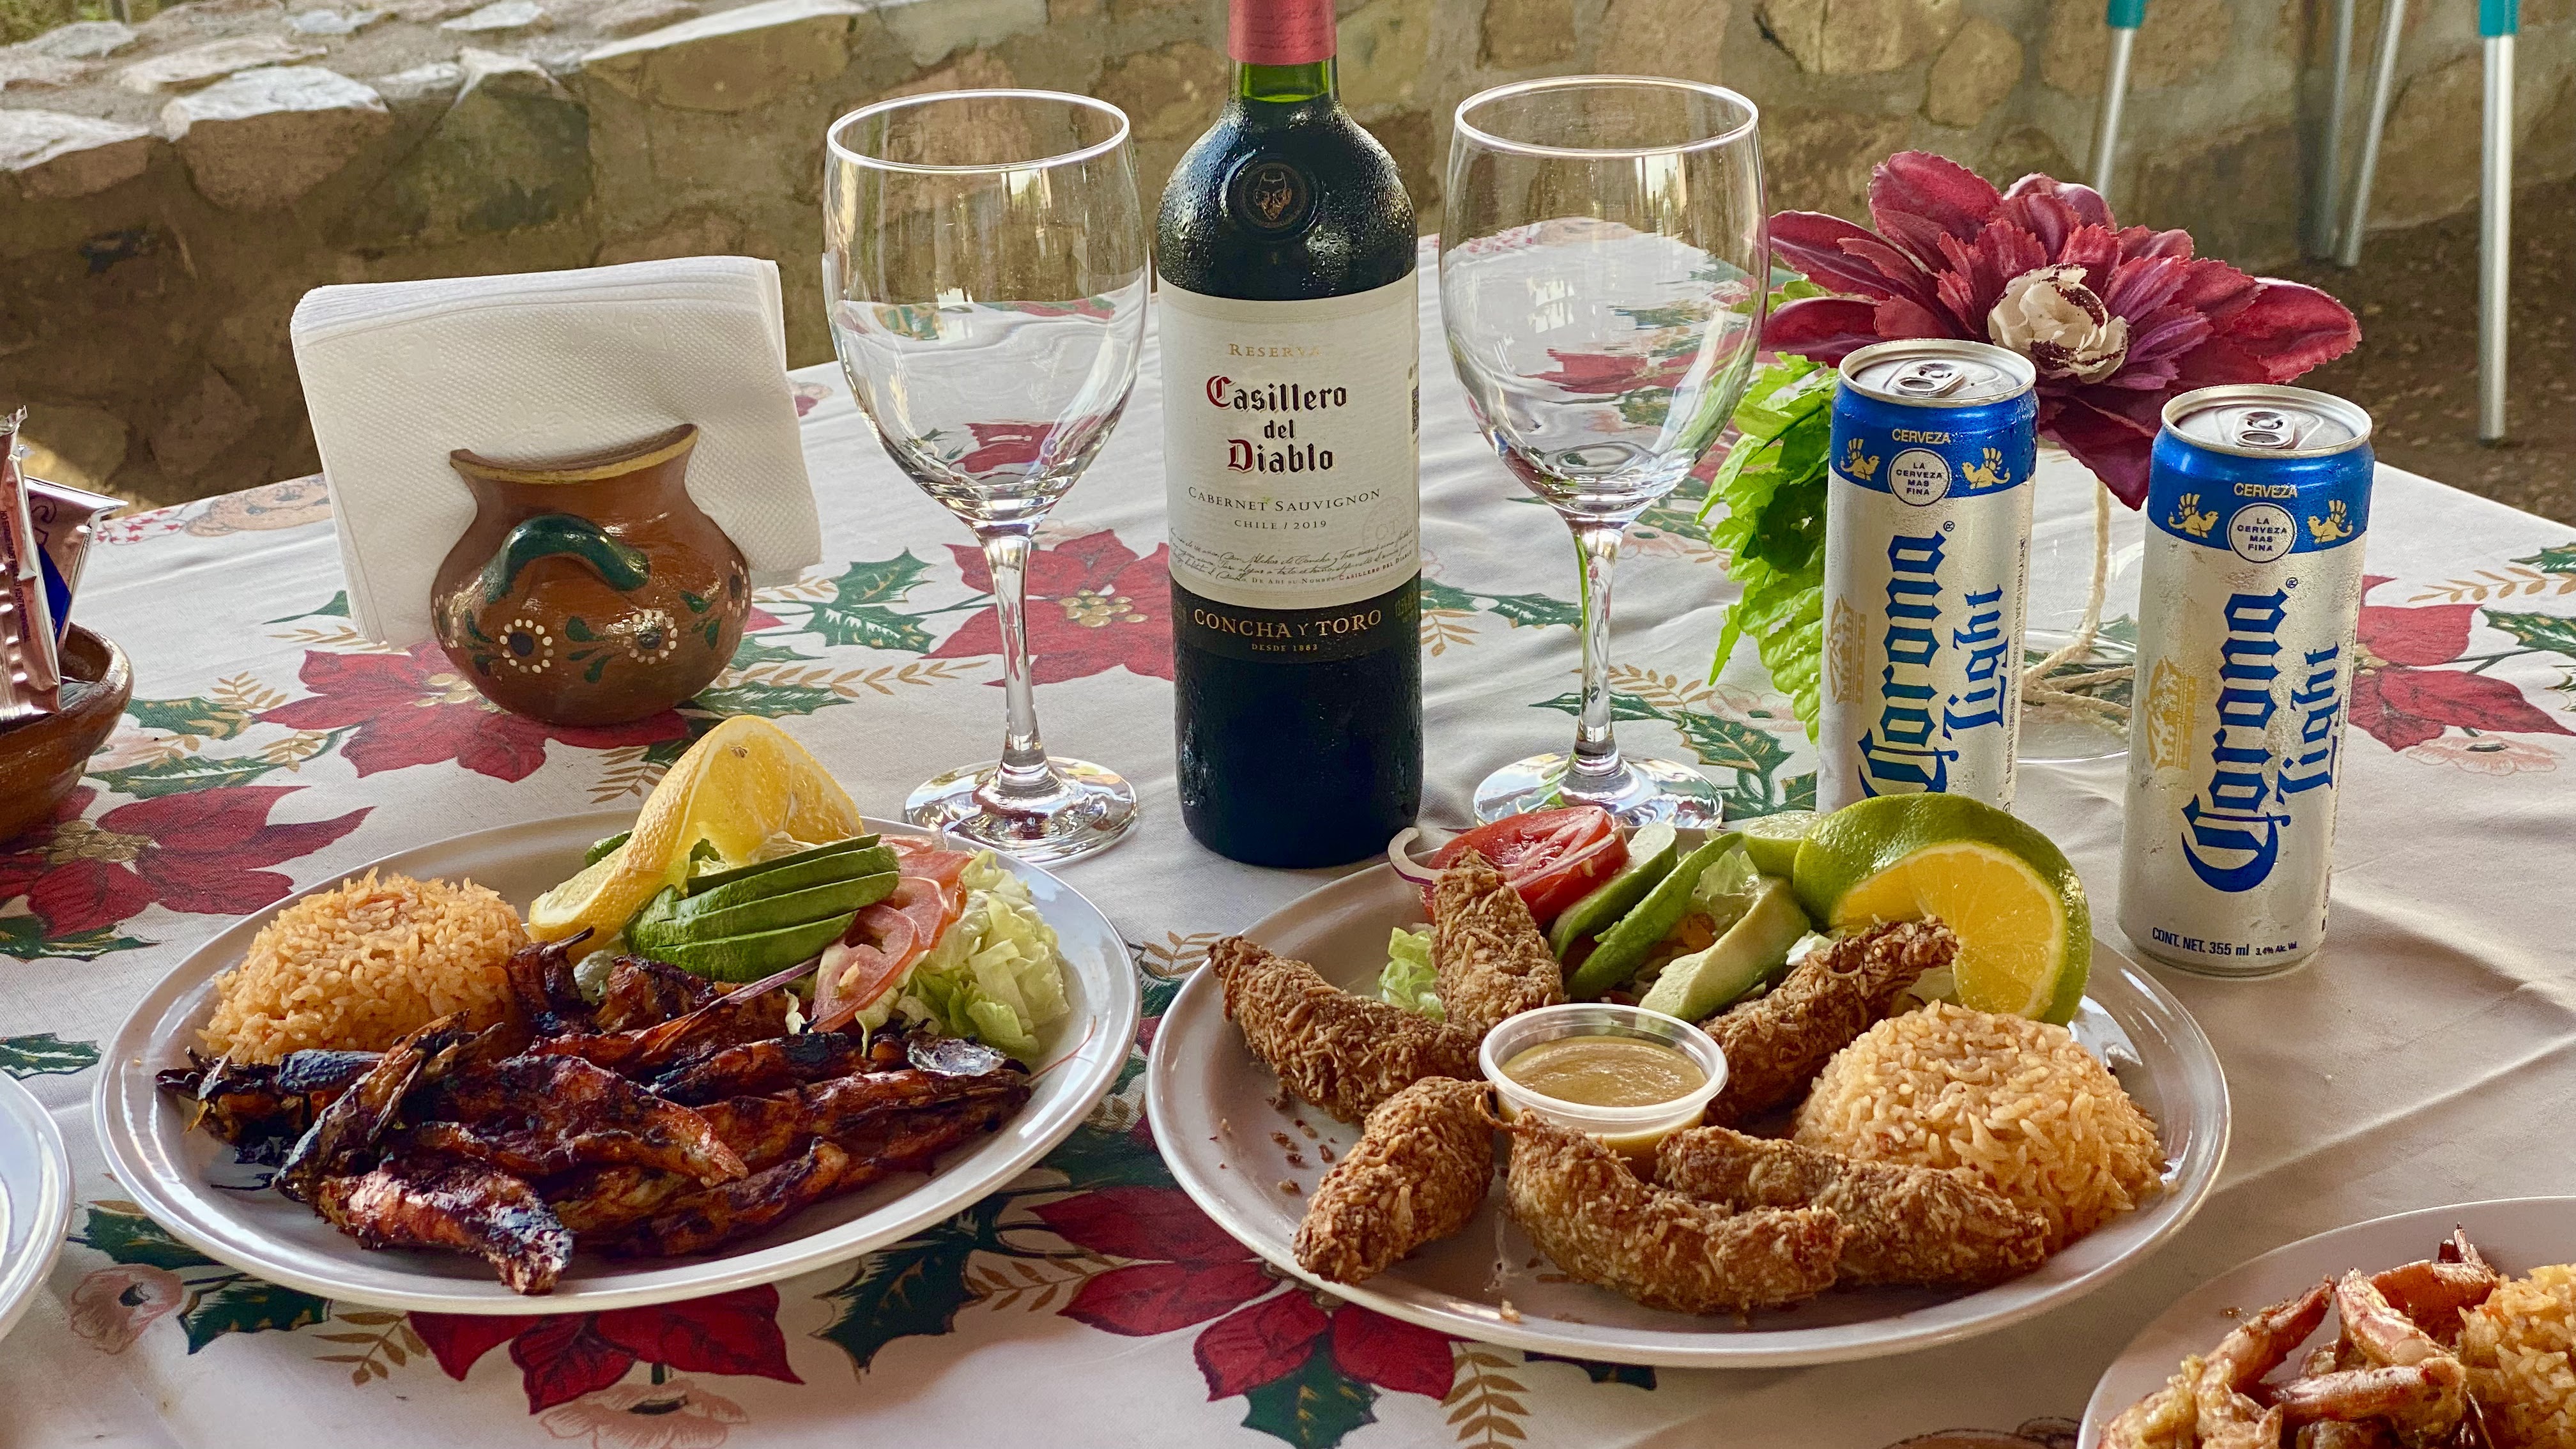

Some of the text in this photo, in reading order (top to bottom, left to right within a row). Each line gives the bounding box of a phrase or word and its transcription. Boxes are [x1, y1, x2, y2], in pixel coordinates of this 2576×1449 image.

[1229, 344, 1322, 357] RESERVA
[1206, 376, 1347, 412] Casillero
[1264, 420, 1296, 440] del
[1892, 429, 1951, 444] CERVEZA
[1227, 439, 1334, 474] Diablo
[1896, 470, 1943, 479] CERVEZA
[1188, 487, 1381, 512] CABERNET SAUVIGNON
[2234, 483, 2297, 498] CERVEZA
[1234, 520, 1277, 530] CHILE
[1294, 520, 1326, 530] 2019
[2237, 525, 2287, 533] CERVEZA
[1194, 608, 1382, 638] CONCHA Y TORO
[1858, 531, 1959, 798] Corona
[1943, 584, 2009, 740] Light
[2276, 641, 2342, 805] Light
[2182, 588, 2290, 893] Corona
[2152, 927, 2180, 947] CONT.
[2182, 937, 2206, 953] NET.
[2209, 942, 2232, 956] 355
[2236, 944, 2250, 956] ml
